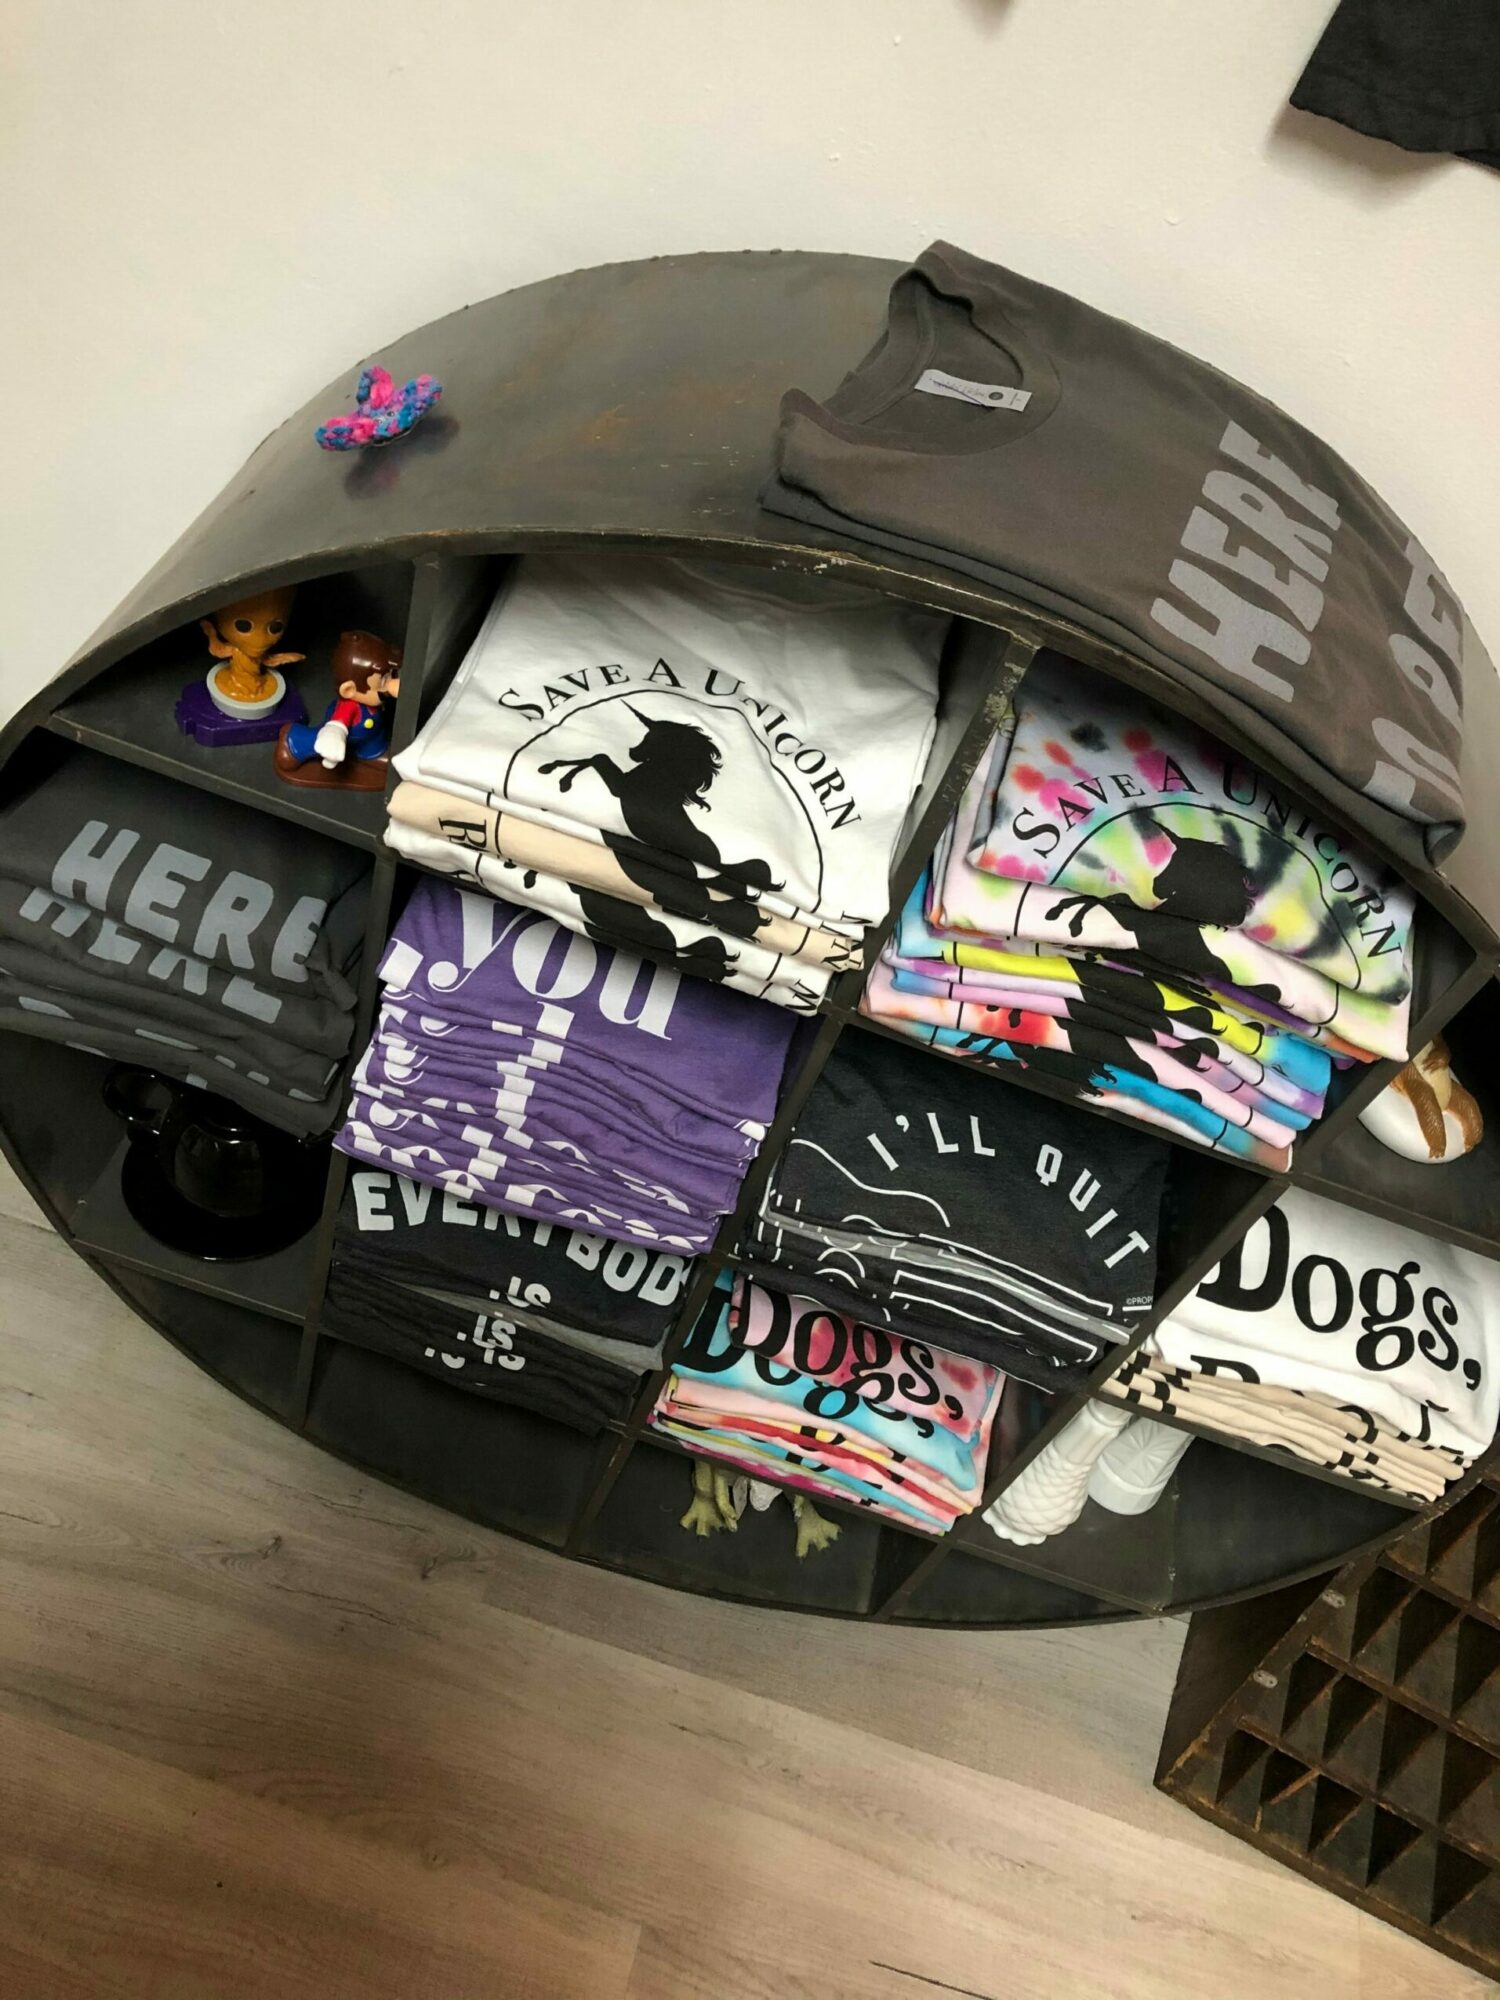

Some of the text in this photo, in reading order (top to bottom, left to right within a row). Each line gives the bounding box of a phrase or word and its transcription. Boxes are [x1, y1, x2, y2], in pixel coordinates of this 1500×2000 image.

[1151, 420, 1341, 703] HERE
[1388, 536, 1464, 735] PE
[498, 657, 862, 832] SAVE A UNICORN
[52, 820, 328, 983] HERE
[1012, 754, 1404, 961] SAVE A UNICORN
[427, 888, 683, 1041] you
[867, 1112, 1150, 1269] I'LL QUIT
[730, 1282, 963, 1420] Dogs,
[1196, 1204, 1481, 1391] Dogs,
